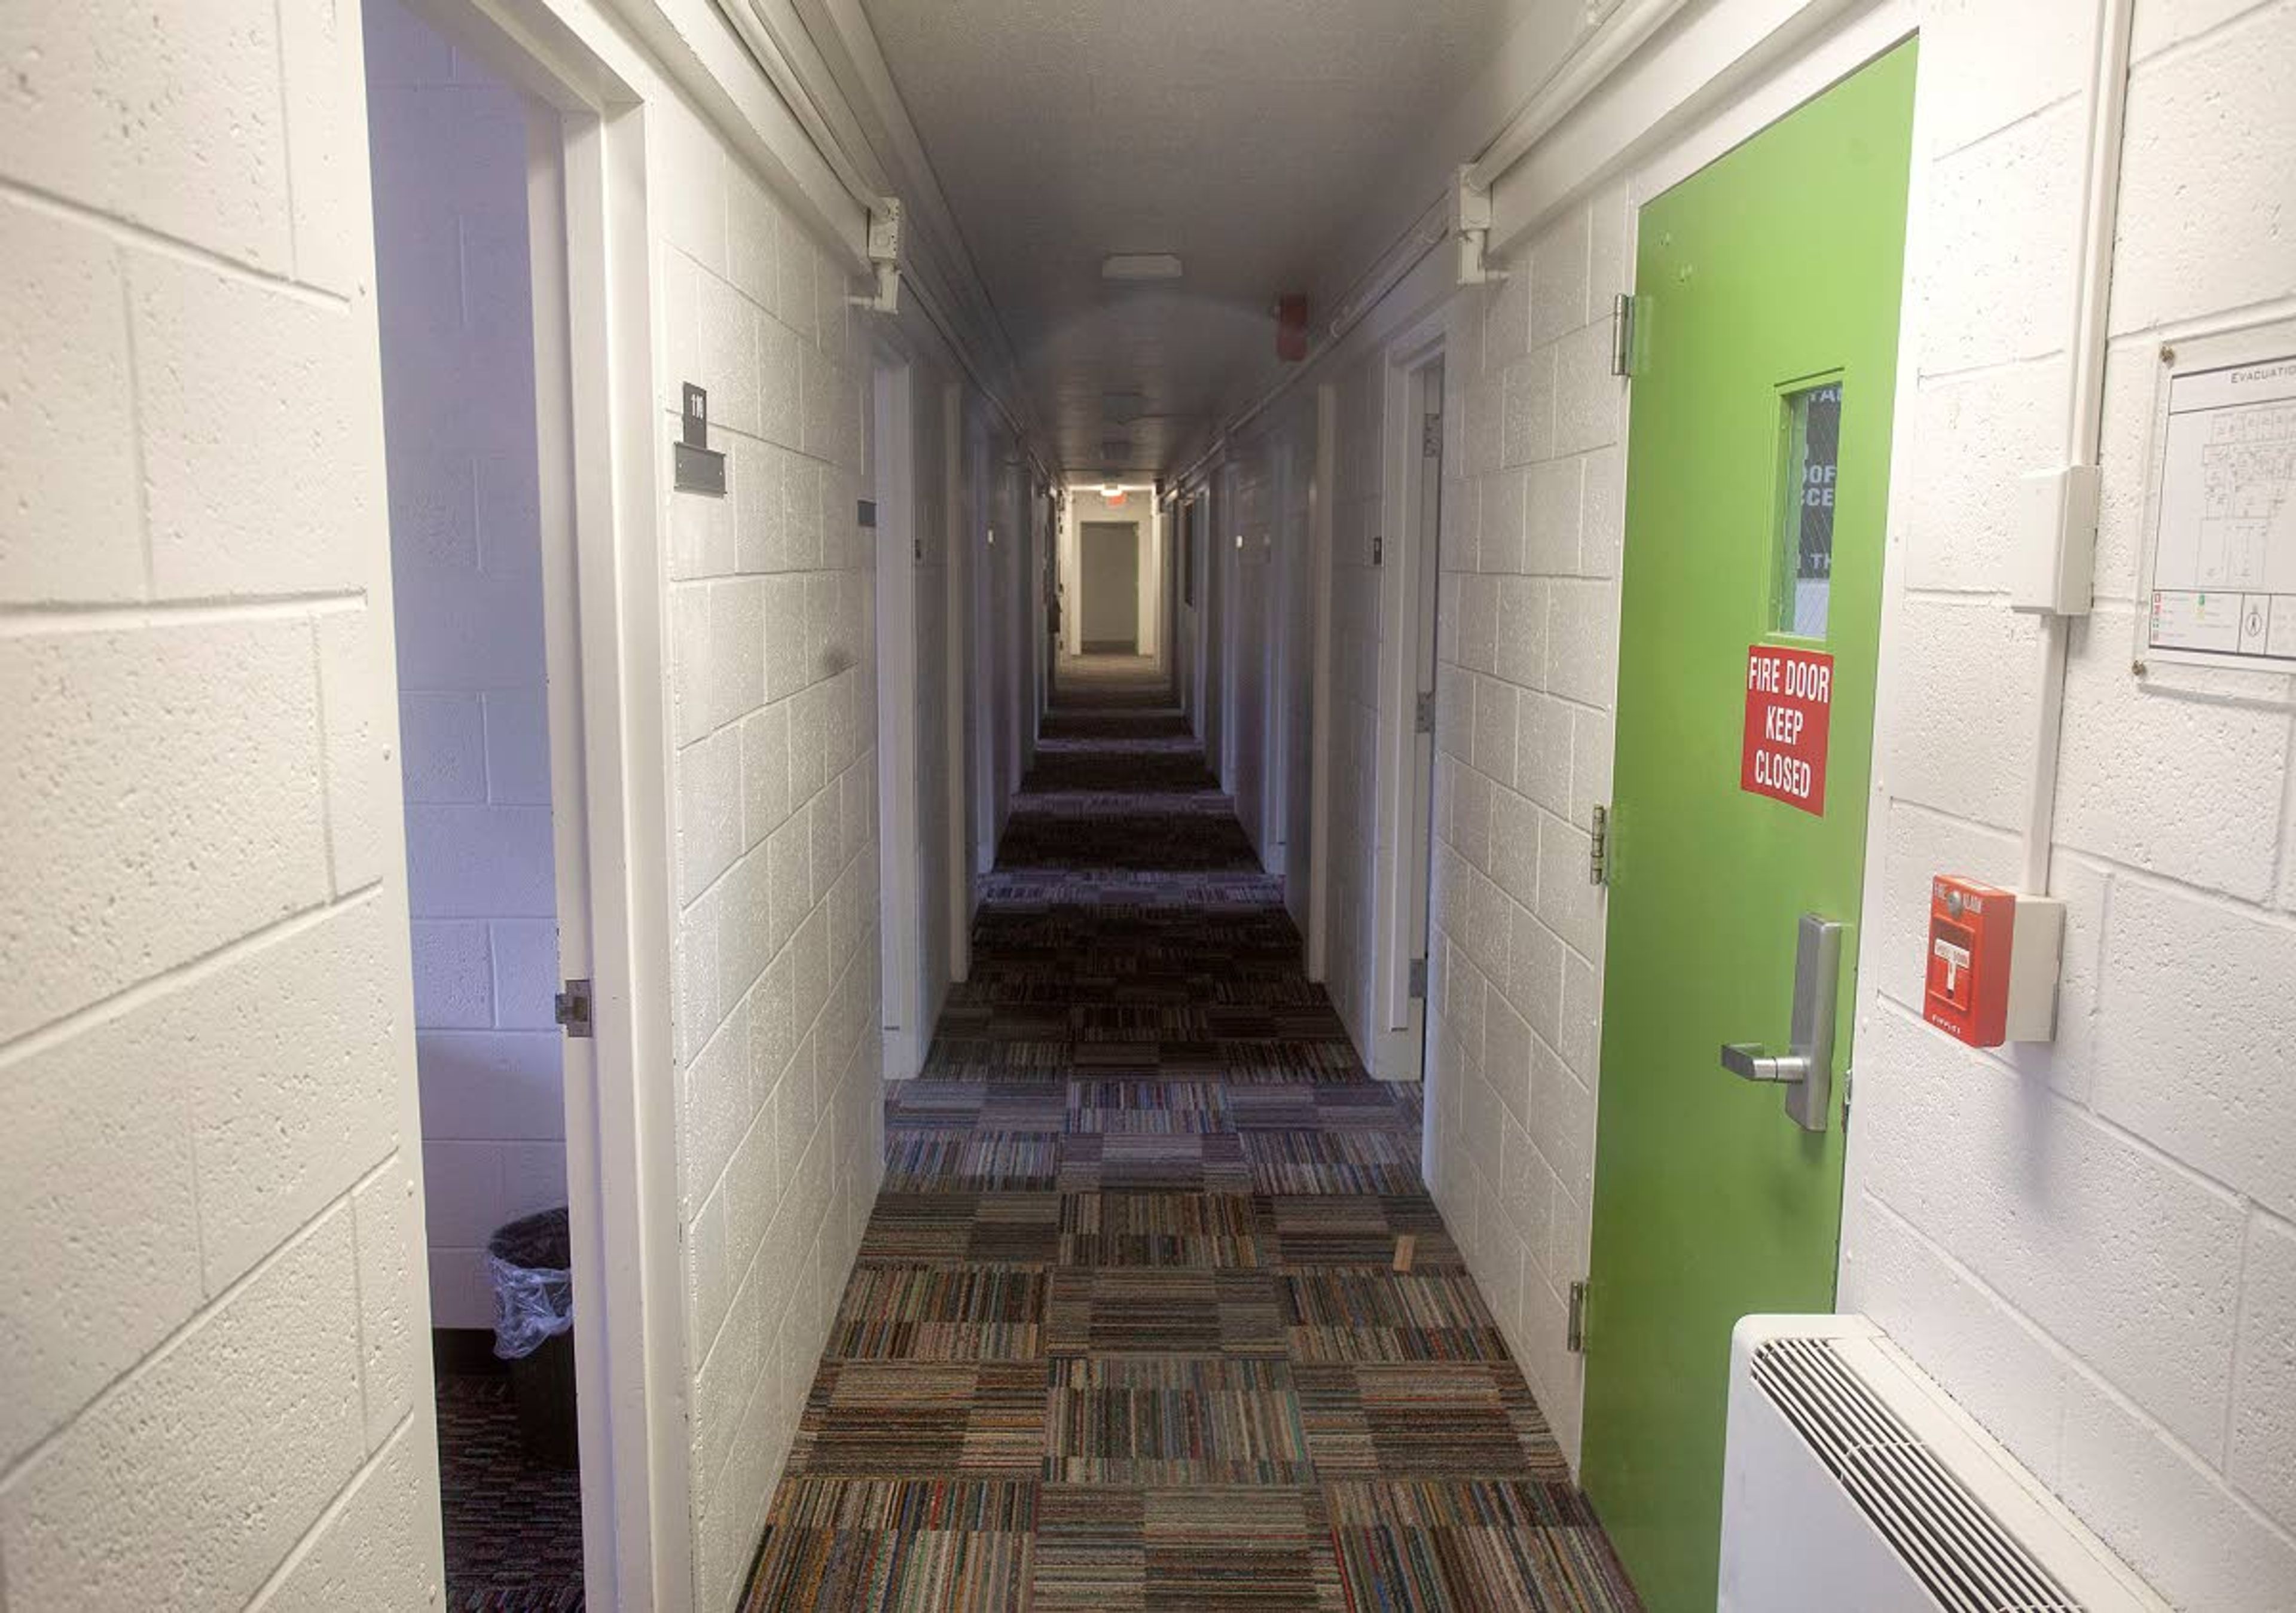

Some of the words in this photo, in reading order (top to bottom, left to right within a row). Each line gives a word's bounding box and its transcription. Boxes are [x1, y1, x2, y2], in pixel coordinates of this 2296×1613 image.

[2231, 365, 2296, 384] EVACUATIO
[1749, 656, 1780, 694] FIRE
[1785, 659, 1830, 703] DOOR
[1766, 705, 1803, 746] KEEP
[1755, 749, 1811, 799] CLOSED
